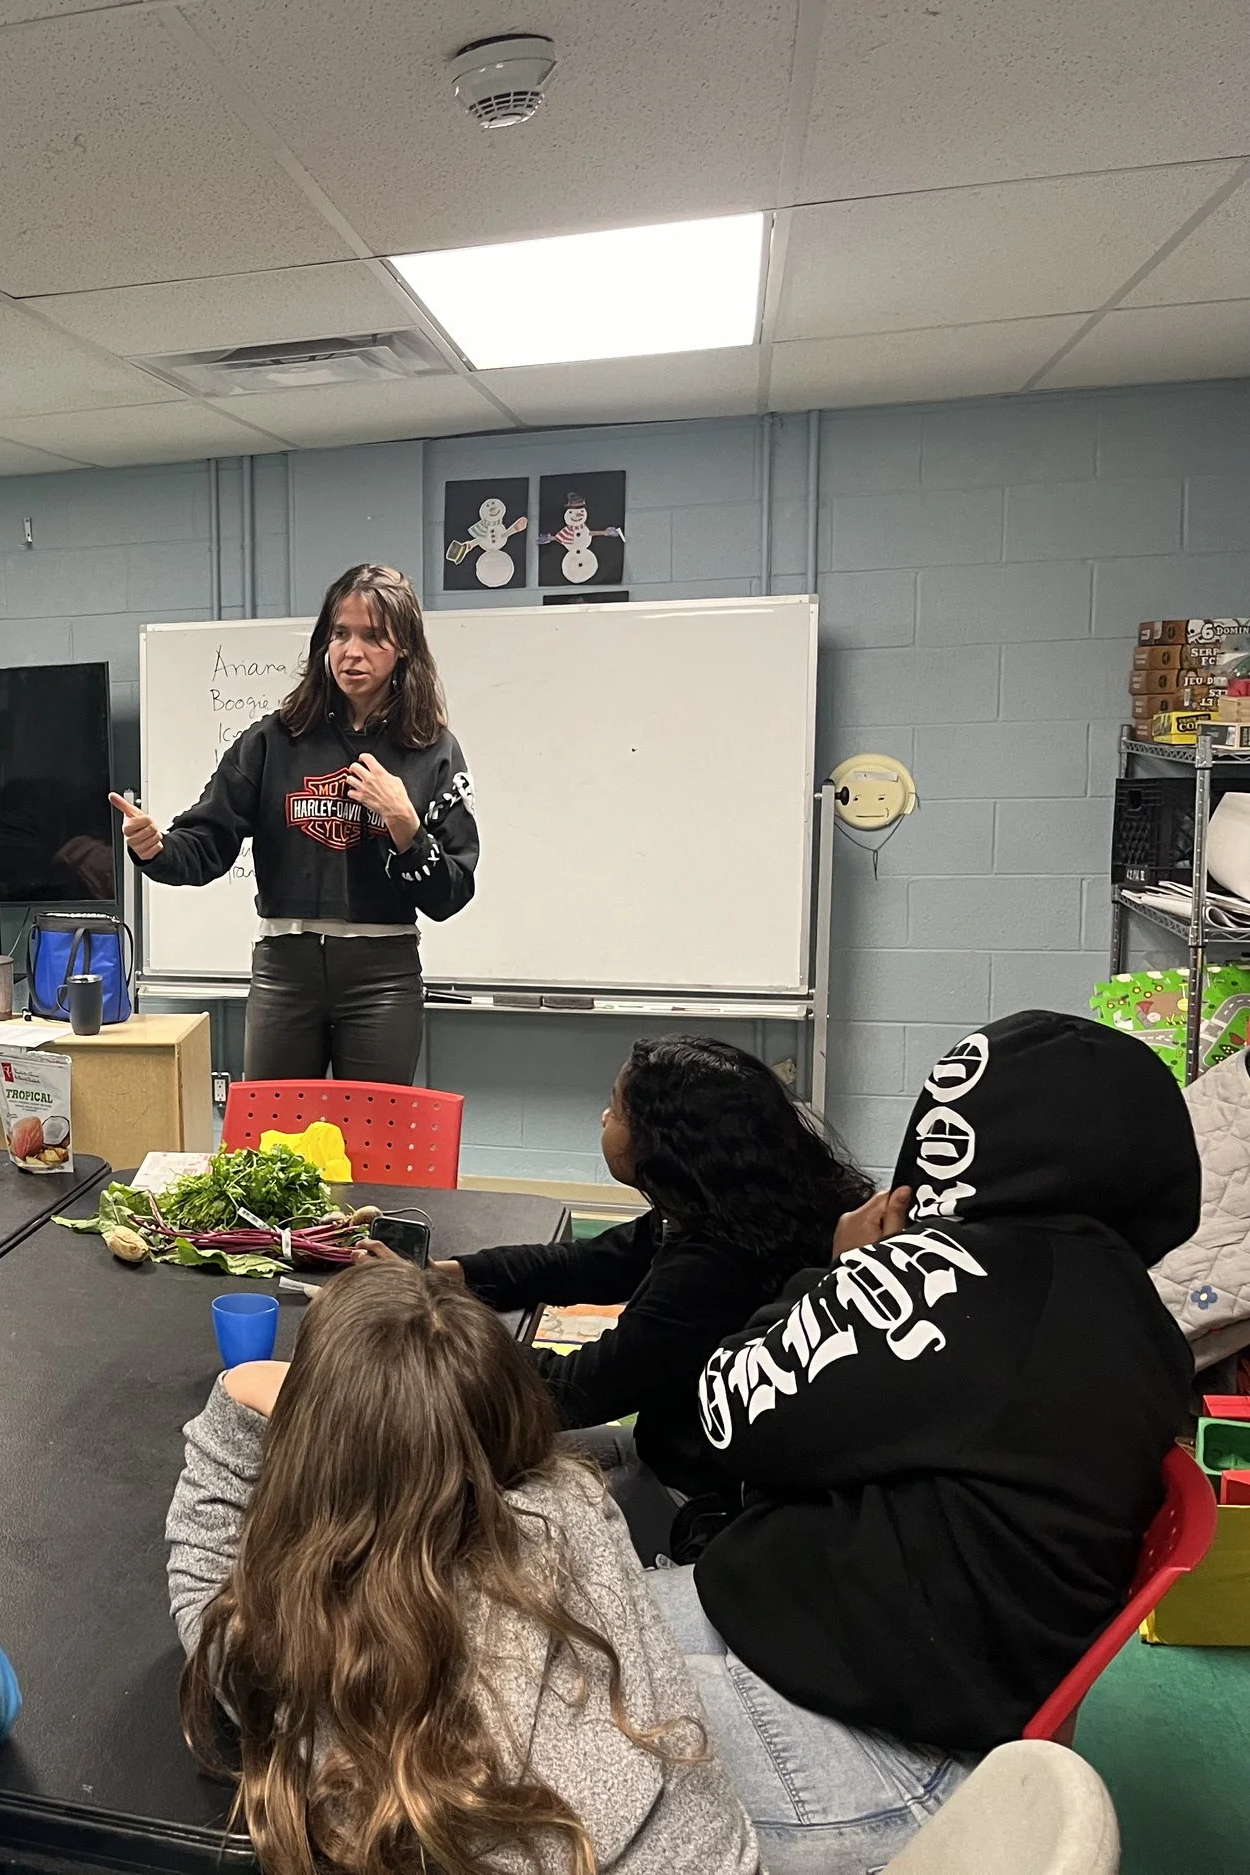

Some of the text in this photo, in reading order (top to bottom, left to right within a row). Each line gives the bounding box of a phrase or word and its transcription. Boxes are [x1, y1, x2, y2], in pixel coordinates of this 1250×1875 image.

[212, 644, 287, 682] Ariana
[209, 688, 270, 719] Boogie
[5, 1088, 54, 1104] TROPICAL
